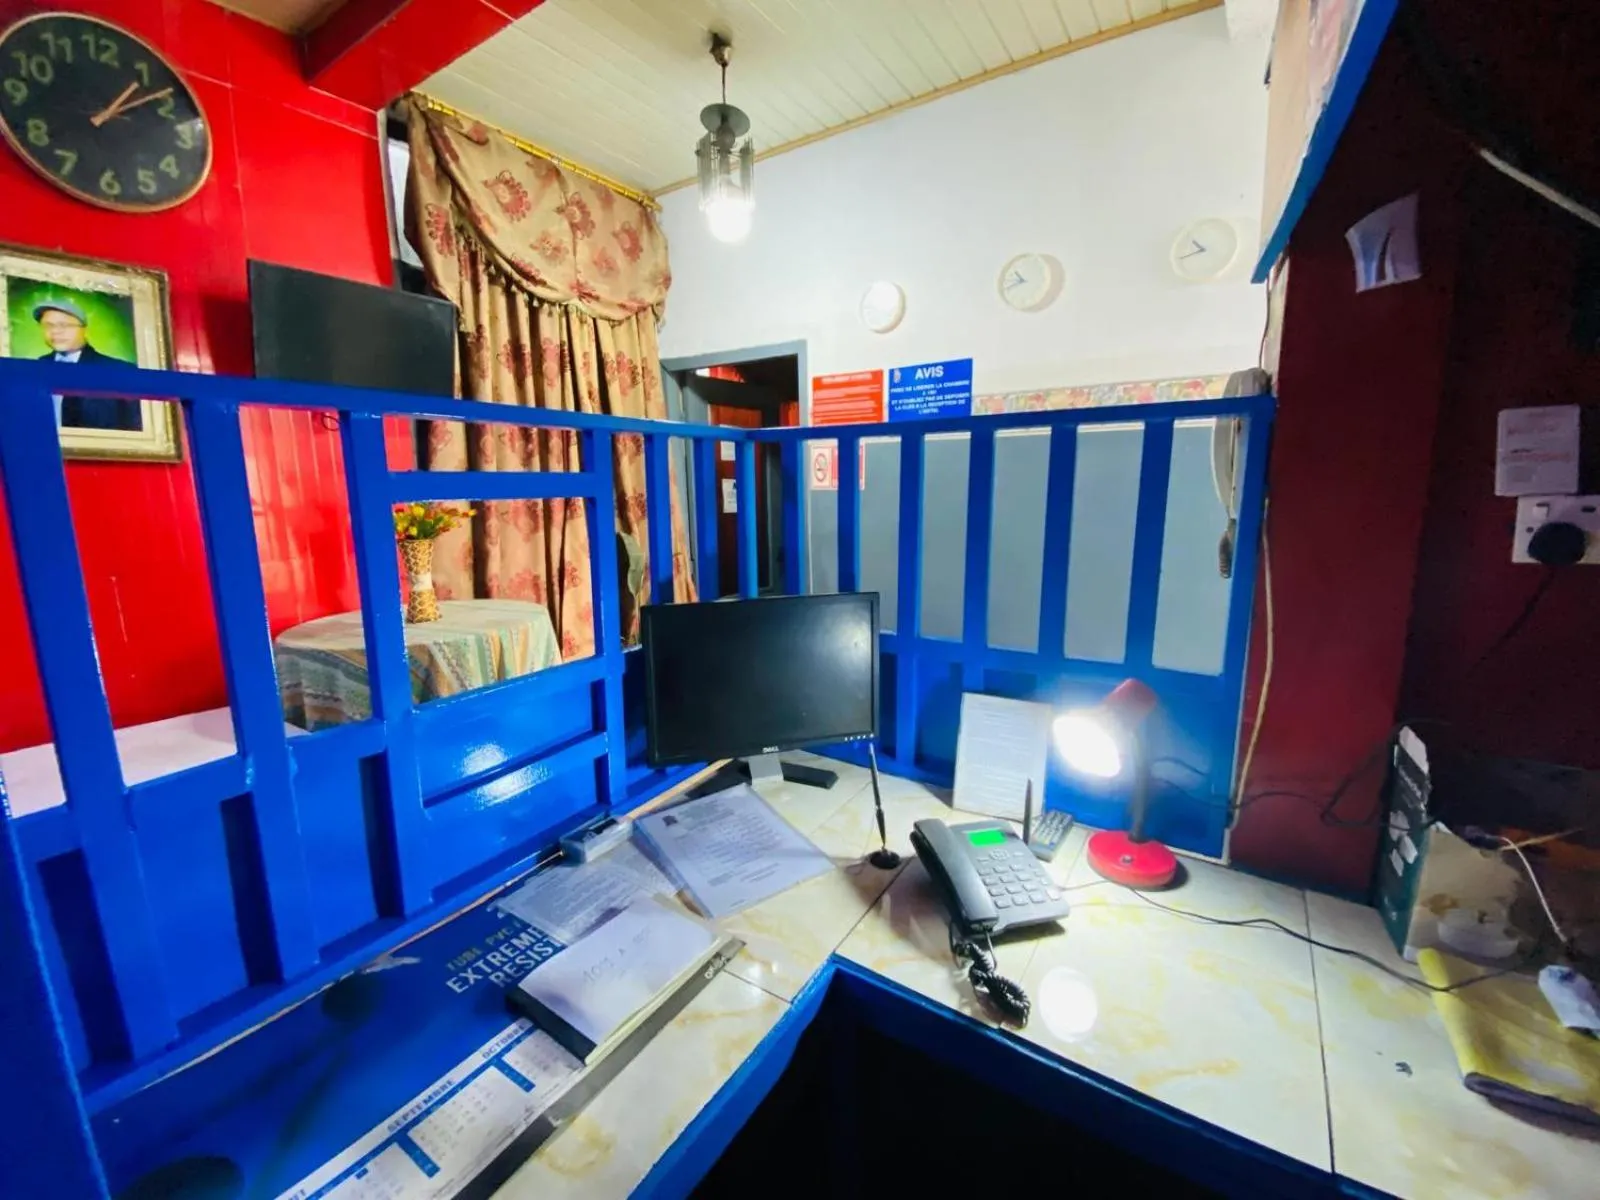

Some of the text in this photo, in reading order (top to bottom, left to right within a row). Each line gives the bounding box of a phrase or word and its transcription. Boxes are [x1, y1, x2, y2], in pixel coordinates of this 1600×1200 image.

[39, 32, 73, 64] 11
[81, 34, 120, 68] 12
[11, 51, 54, 84] 10
[133, 61, 149, 87] 1
[3, 77, 28, 106] 9
[157, 91, 176, 120] 2
[27, 118, 49, 147] 8
[174, 122, 193, 149] 3
[54, 149, 78, 176] 7
[159, 154, 180, 179] 4
[100, 169, 121, 195] 6
[137, 168, 157, 195] 5
[915, 365, 944, 380] AVIS
[762, 745, 779, 754] DELL
[482, 1023, 526, 1060] OCTOBRE
[387, 1078, 455, 1133] SEPTEMBRE
